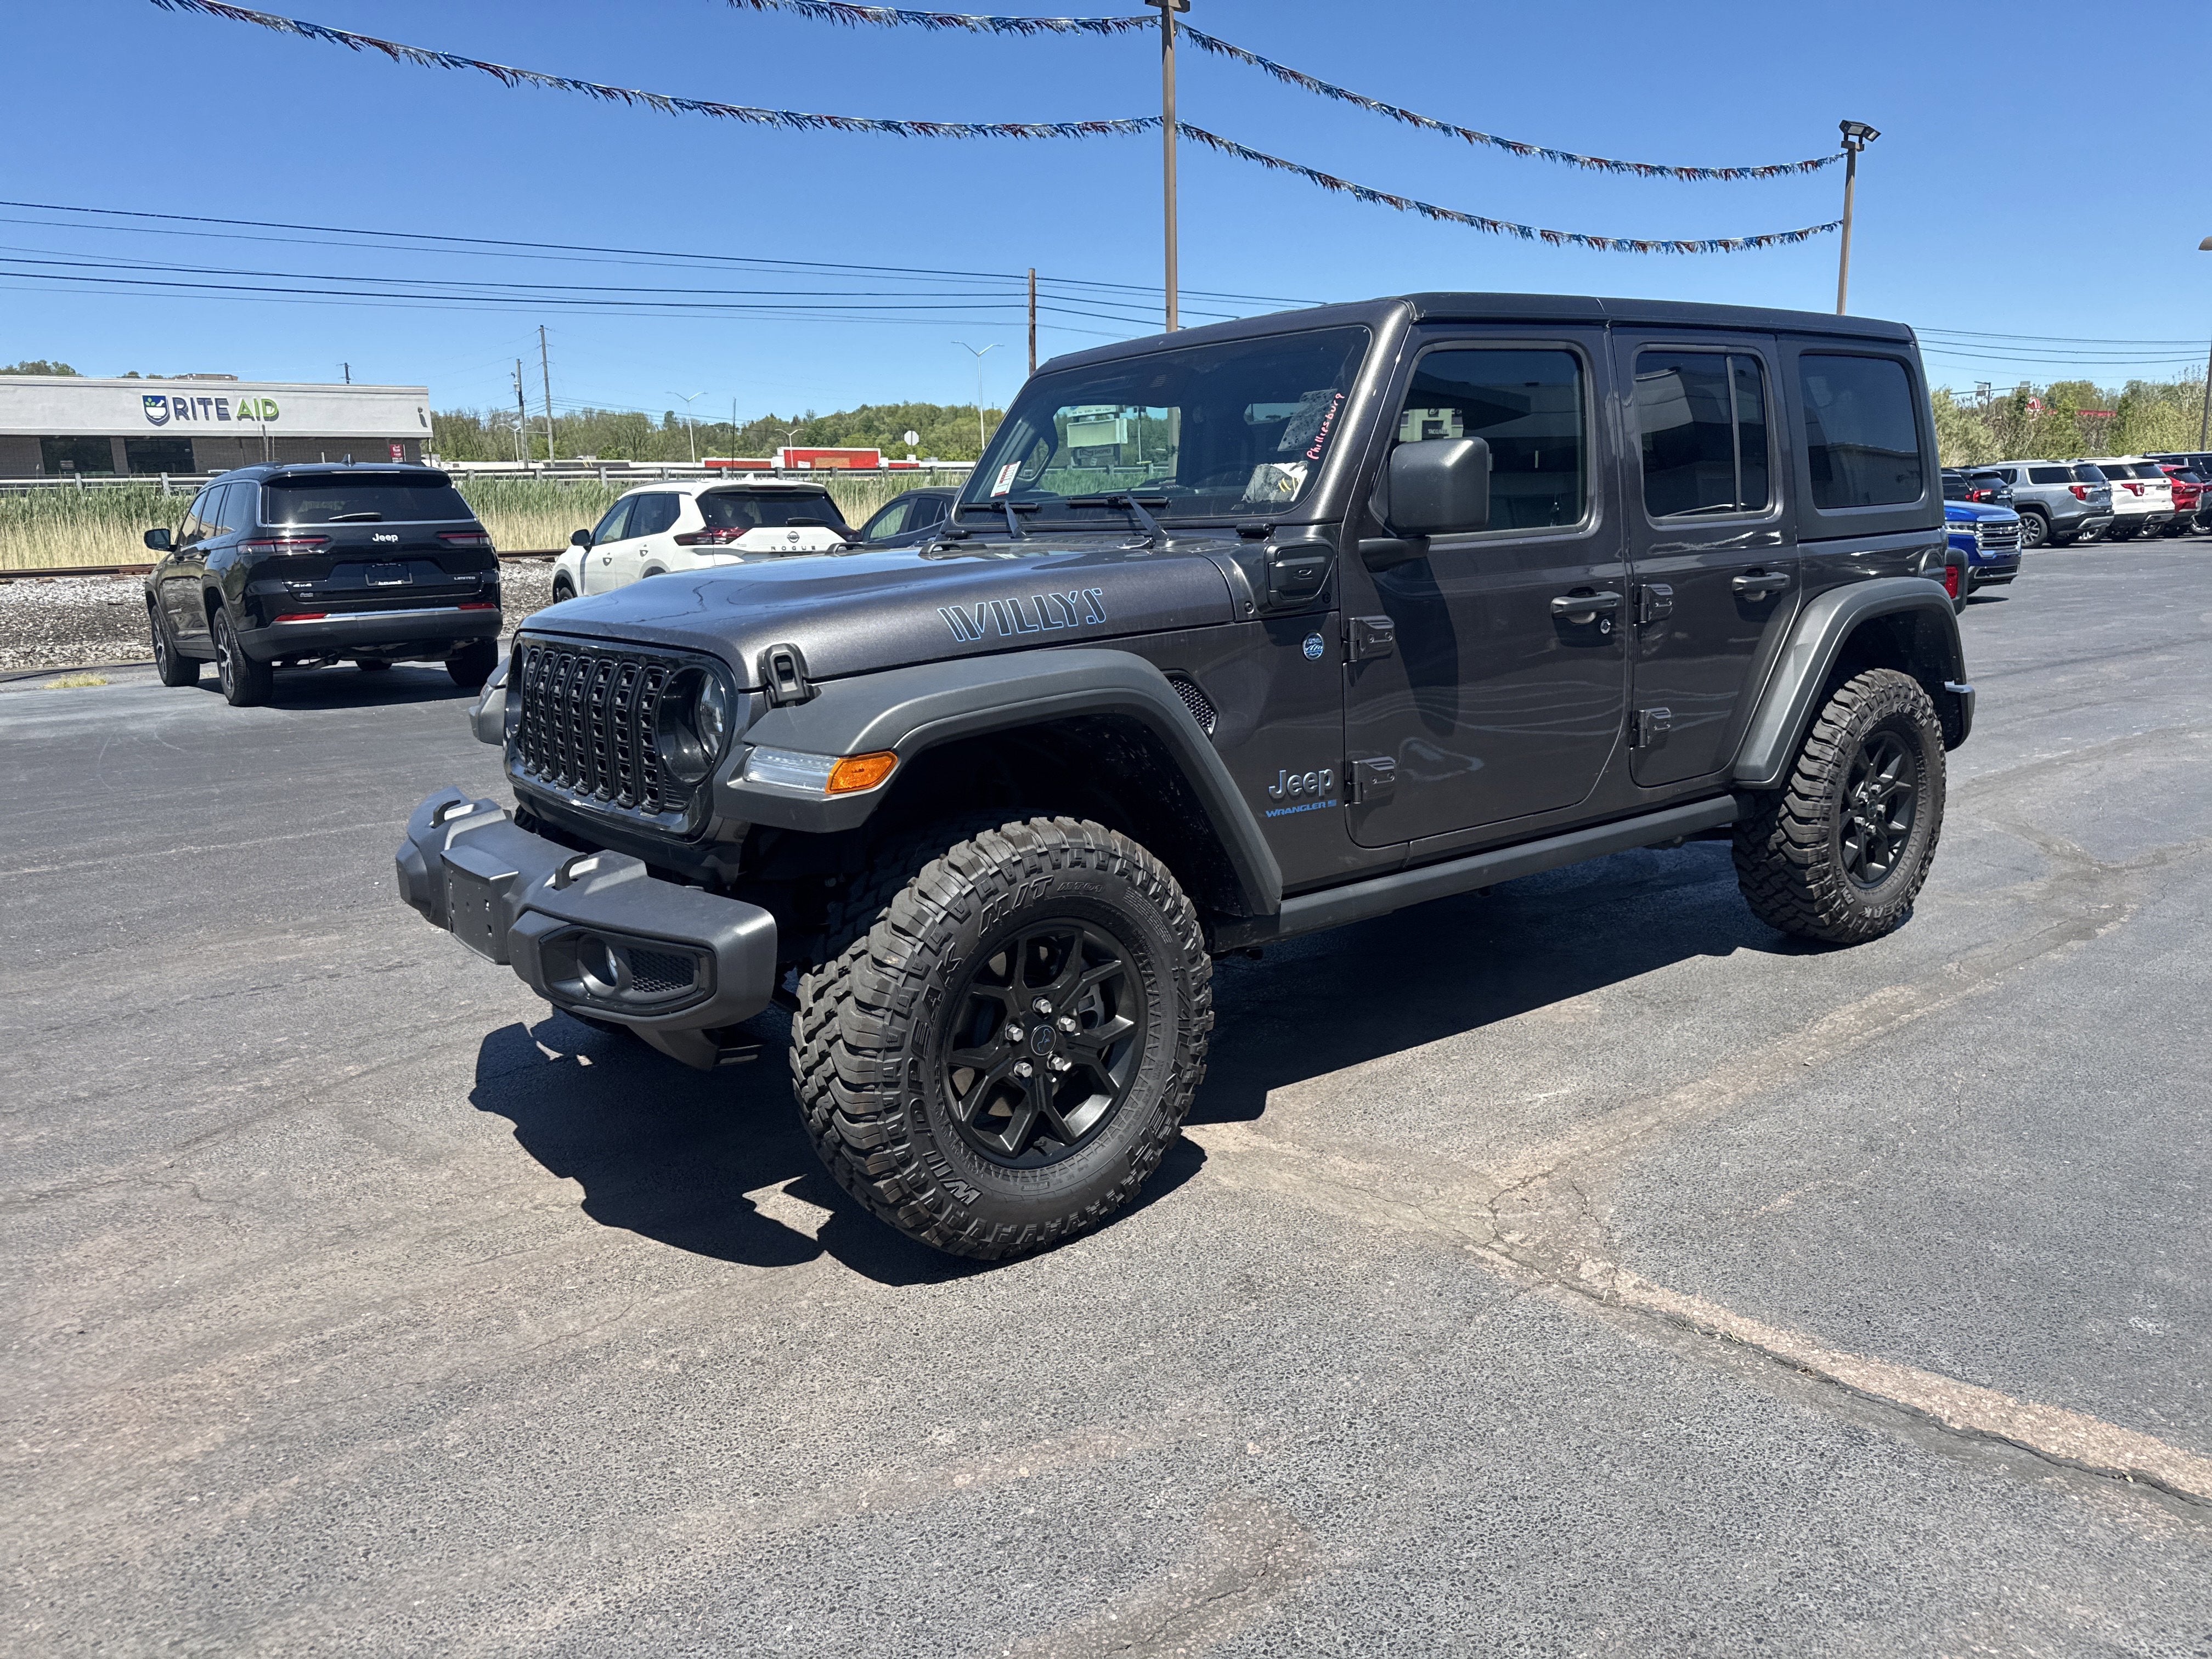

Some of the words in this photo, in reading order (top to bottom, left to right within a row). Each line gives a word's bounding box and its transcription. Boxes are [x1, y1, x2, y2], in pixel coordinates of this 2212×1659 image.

[172, 397, 229, 417] RITE
[237, 398, 278, 418] AID
[373, 533, 398, 543] Jeep
[936, 588, 1107, 642] WILLYS
[1268, 769, 1334, 799] Jeep
[1265, 802, 1326, 817] WRANGLER
